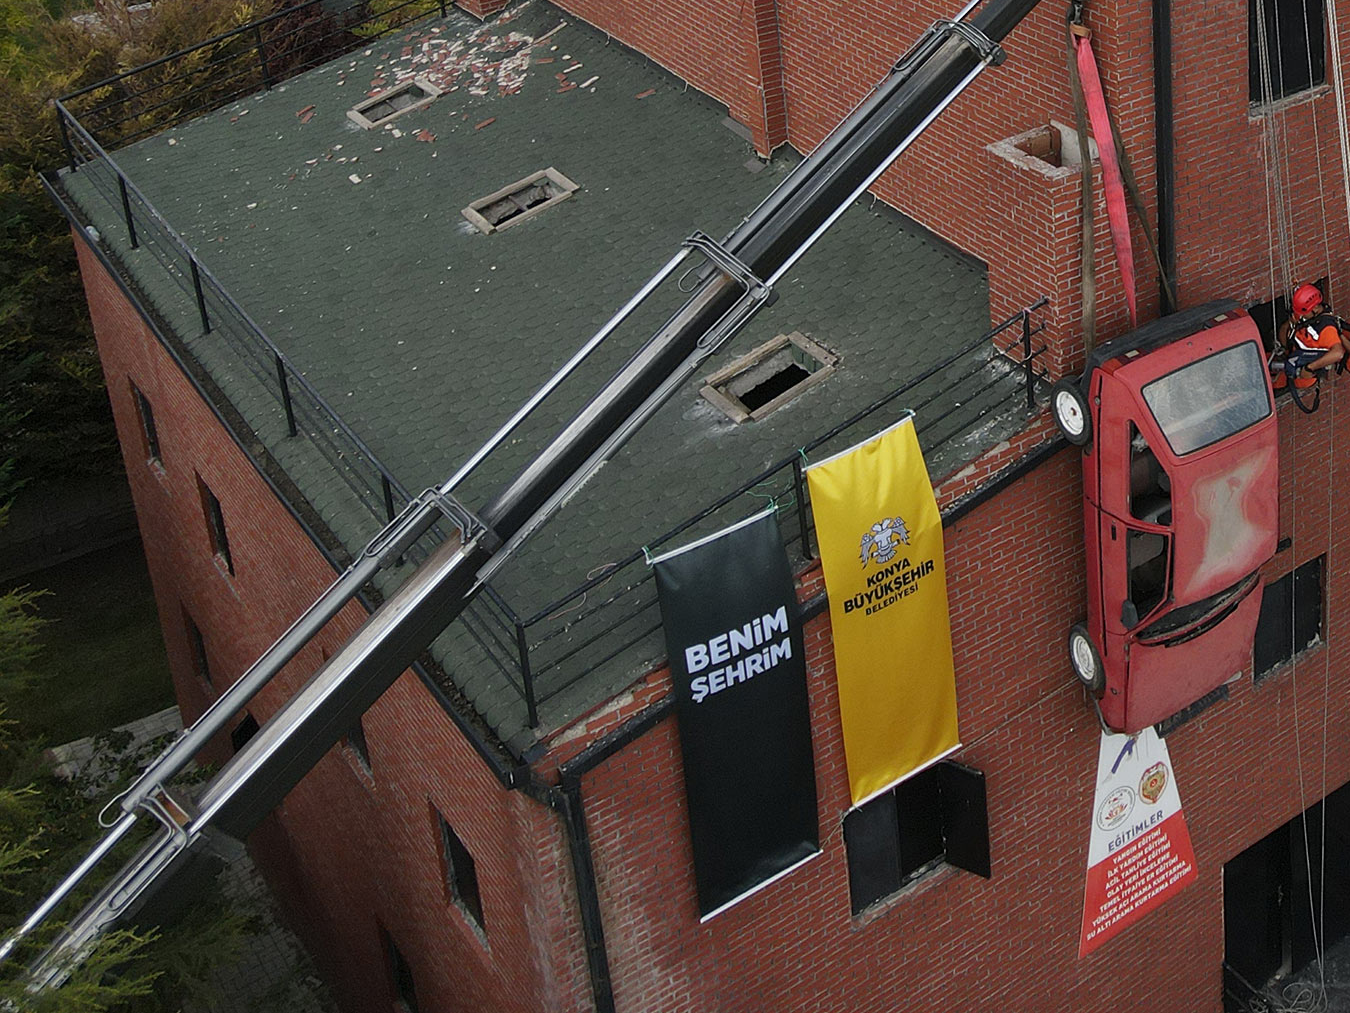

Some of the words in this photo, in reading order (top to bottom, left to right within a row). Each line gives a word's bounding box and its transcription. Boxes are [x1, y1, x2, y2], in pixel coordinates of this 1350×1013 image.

[843, 559, 935, 614] BÜYÜKŞEHİR
[866, 557, 911, 588] KONYA
[865, 582, 919, 616] BELEDİYESİ
[1108, 810, 1163, 852] EĞİTİMLER
[1105, 876, 1120, 890] ACİL
[1107, 866, 1119, 878] İLK
[1092, 906, 1118, 927] YÜKSEK
[1129, 883, 1153, 902] ARAMA
[1152, 860, 1186, 887] KURTARMA
[1099, 895, 1120, 912] TEMEL
[1107, 883, 1124, 898] OLAY
[1086, 930, 1096, 941] SU
[1111, 905, 1134, 924] ARAMA
[1134, 881, 1169, 908] KURTARMA
